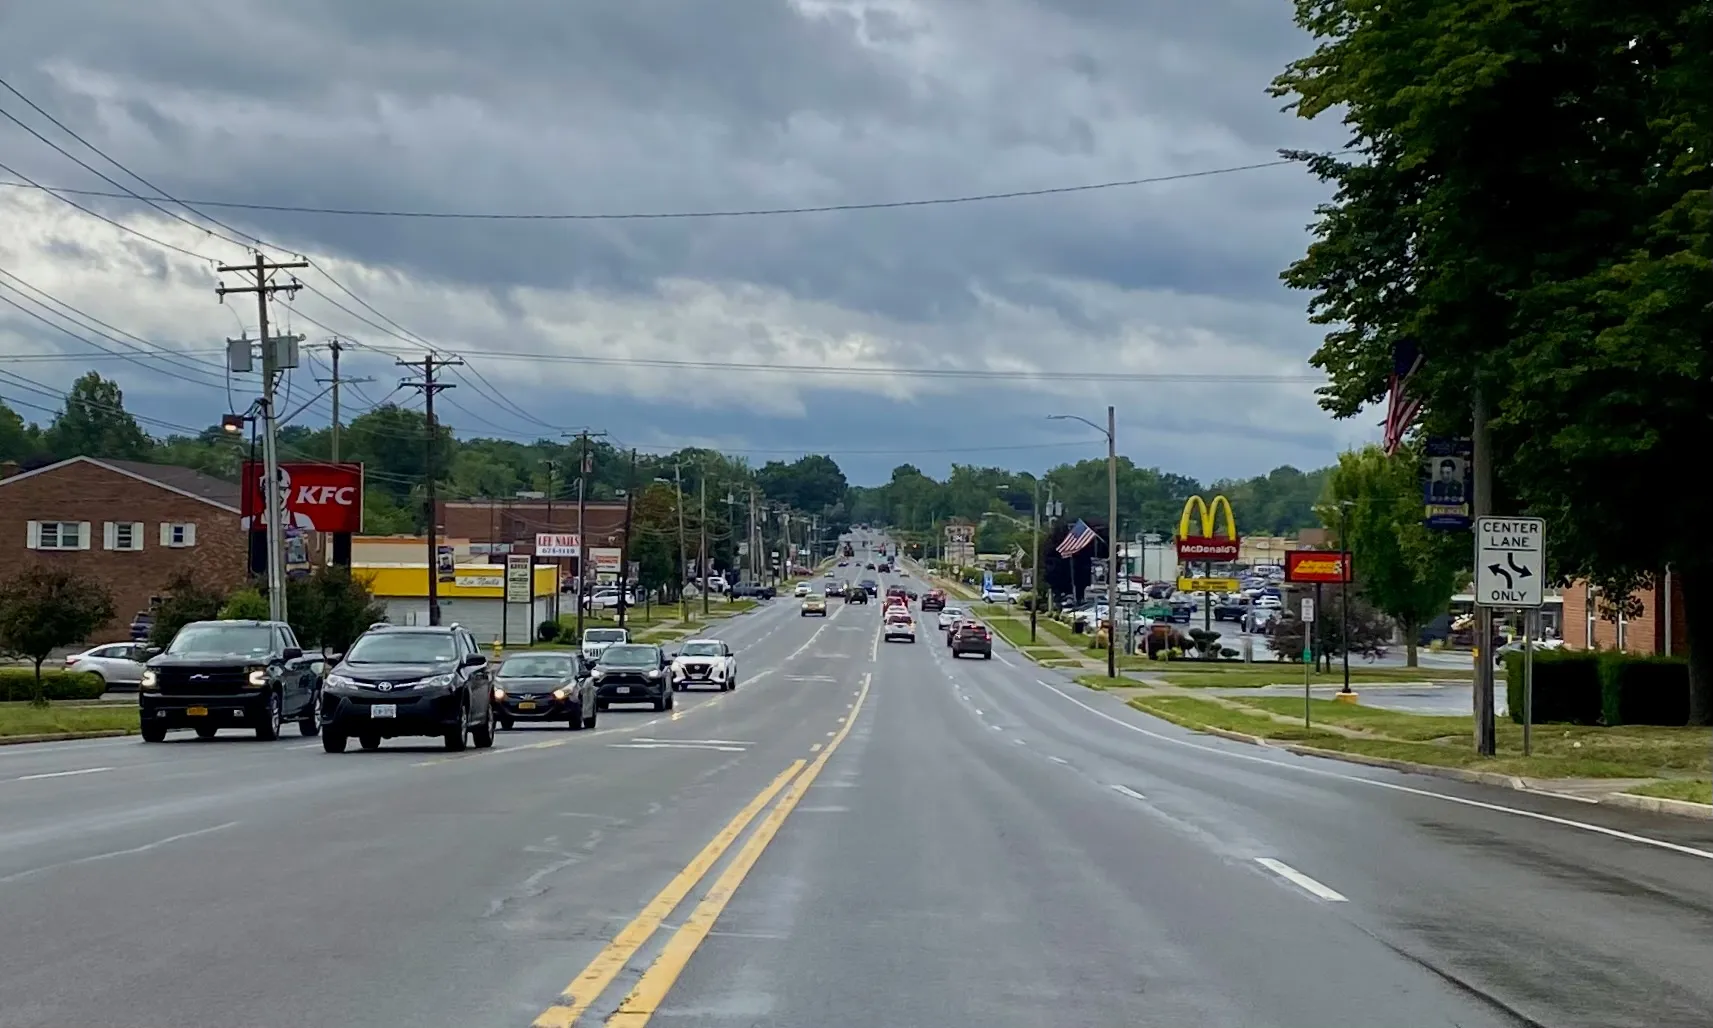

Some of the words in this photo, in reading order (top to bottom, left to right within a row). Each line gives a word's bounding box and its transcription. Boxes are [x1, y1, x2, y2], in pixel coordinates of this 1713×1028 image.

[296, 485, 355, 505] KFC
[1483, 522, 1538, 533] CENTER
[538, 535, 553, 546] LEE
[555, 535, 579, 546] NAILS
[1491, 536, 1530, 547] LANE
[1181, 544, 1237, 554] McDonald's
[1491, 590, 1527, 602] ONLY
